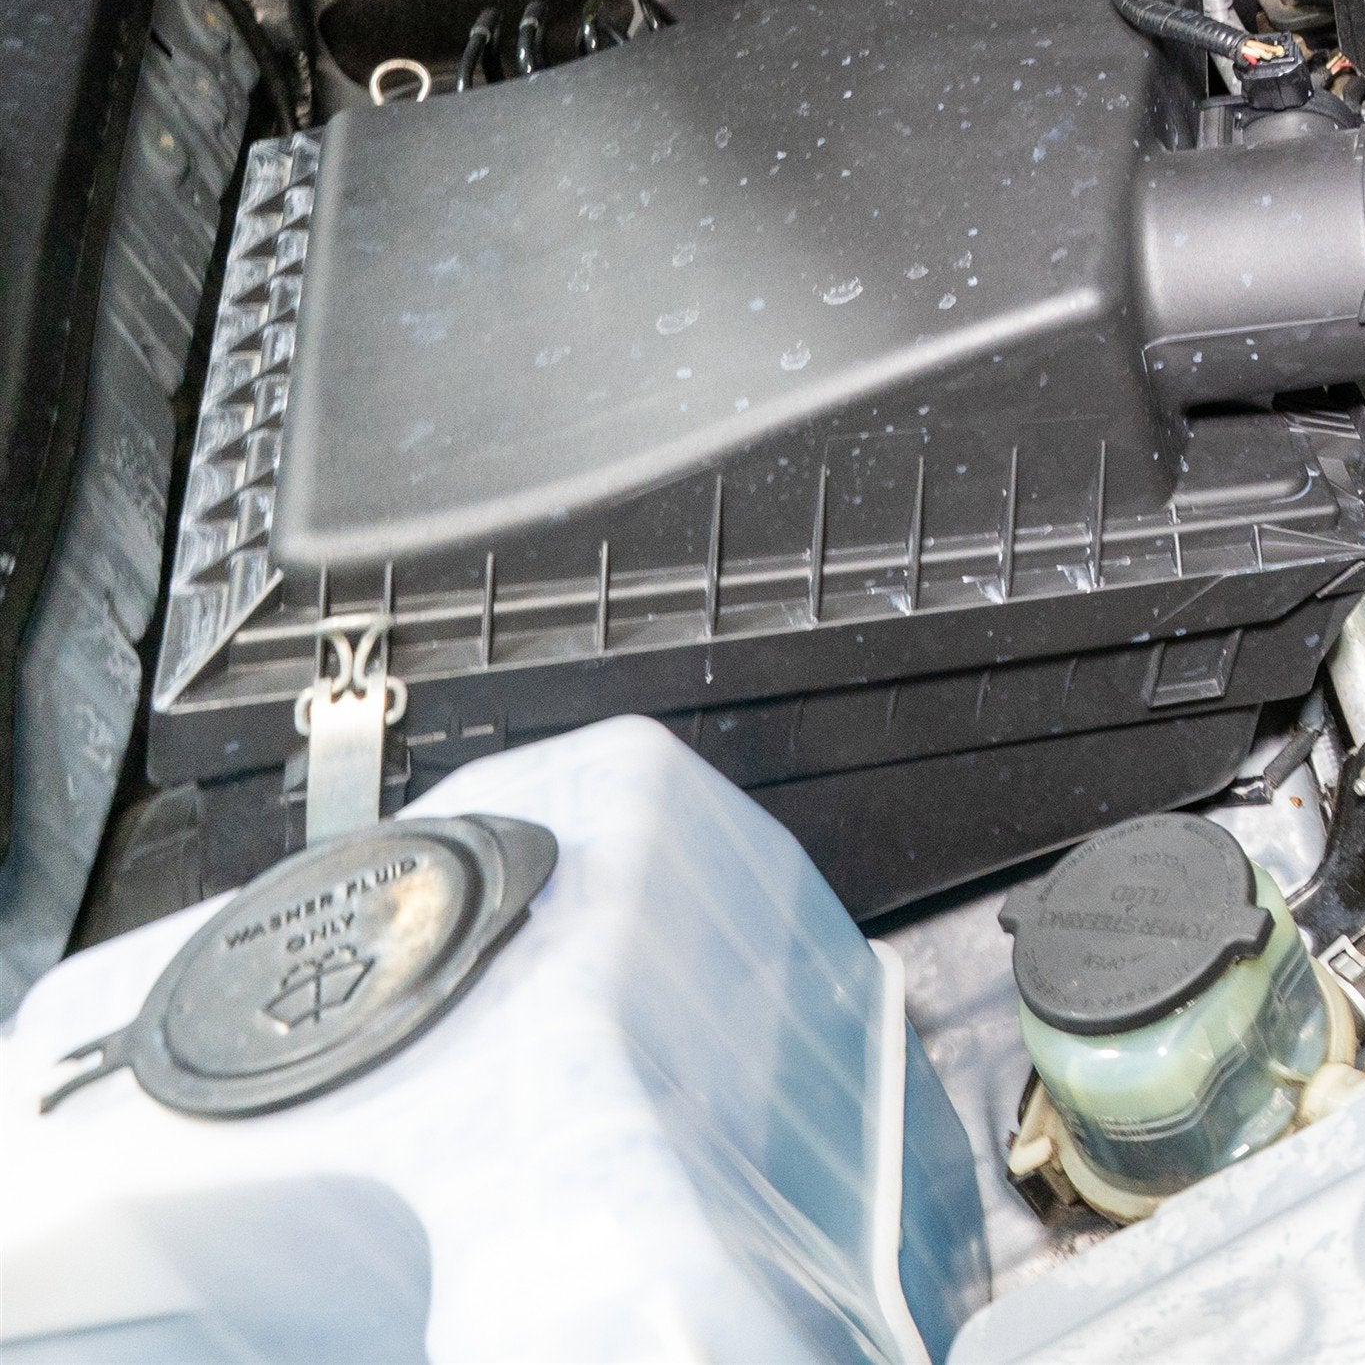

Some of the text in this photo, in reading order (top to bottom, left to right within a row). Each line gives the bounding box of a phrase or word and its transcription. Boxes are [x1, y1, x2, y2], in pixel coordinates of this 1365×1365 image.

[224, 857, 418, 950] WASHER FLUID
[285, 911, 356, 955] ONLY
